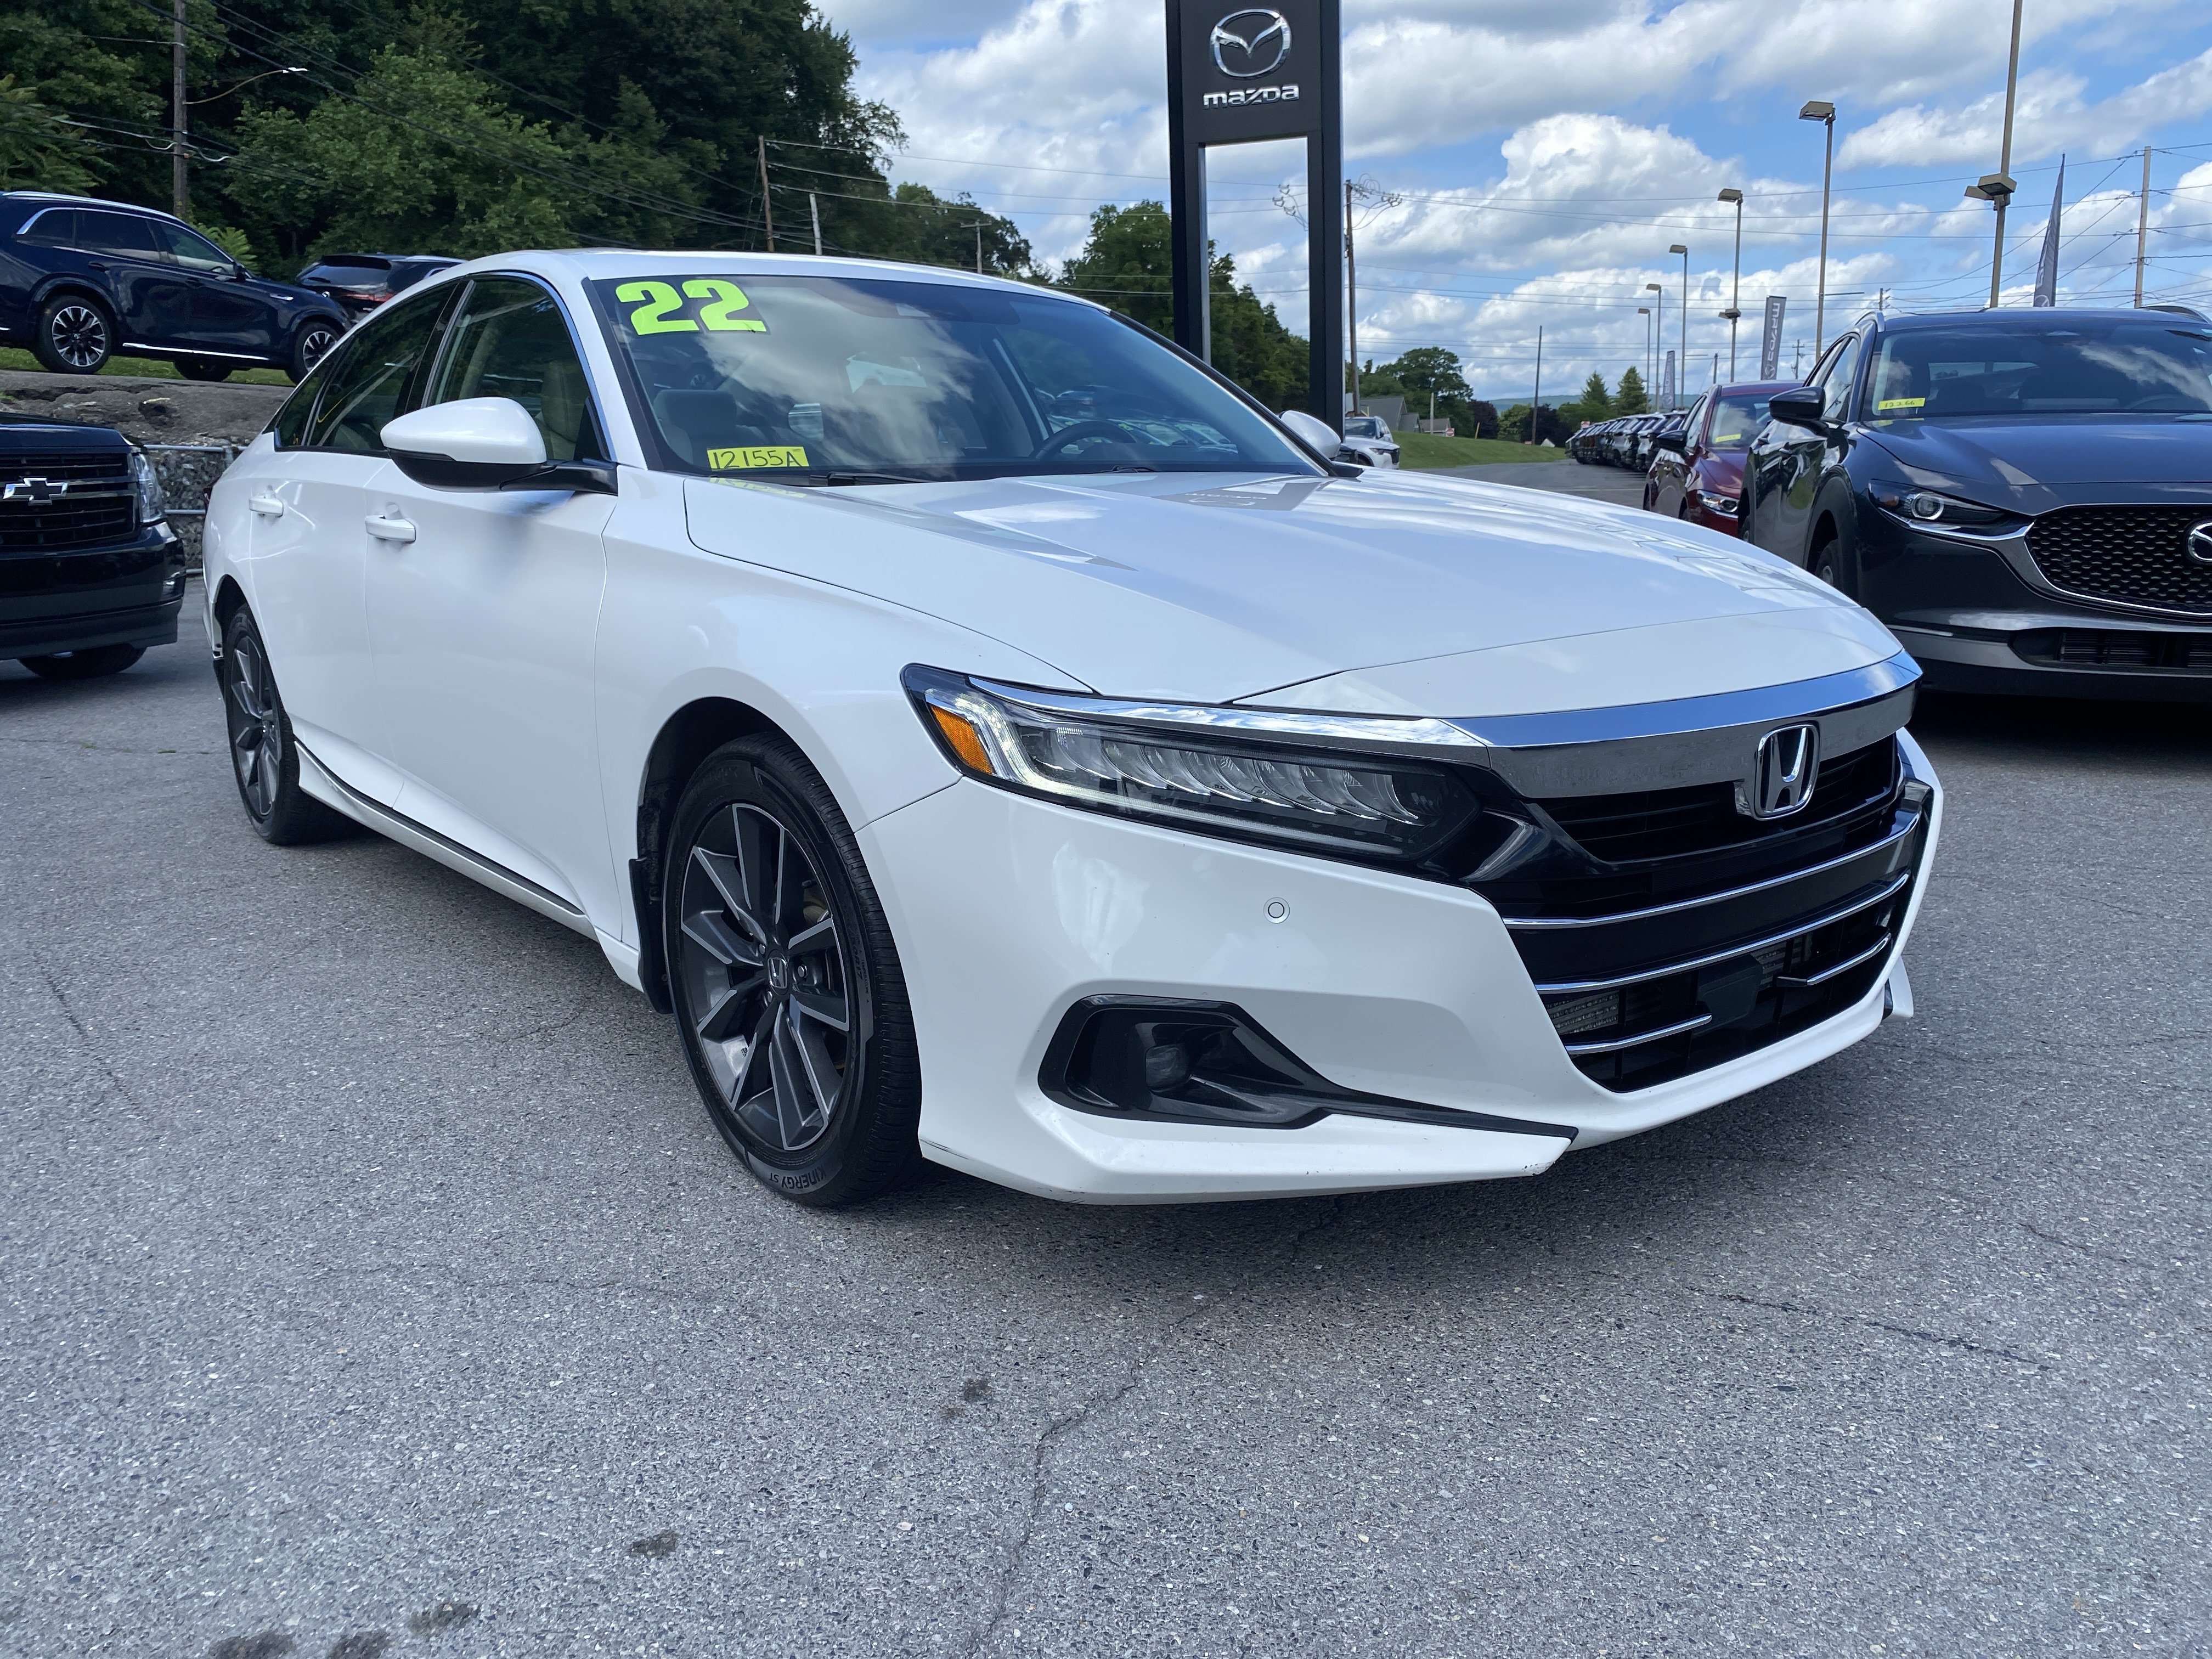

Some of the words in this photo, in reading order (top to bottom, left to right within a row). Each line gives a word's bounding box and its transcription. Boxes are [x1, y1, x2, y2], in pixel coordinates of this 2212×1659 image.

[1203, 83, 1300, 109] mazda
[615, 279, 767, 335] 22
[713, 450, 803, 469] 12155A
[769, 1172, 779, 1183] ST
[781, 1163, 827, 1189] KINERGY
